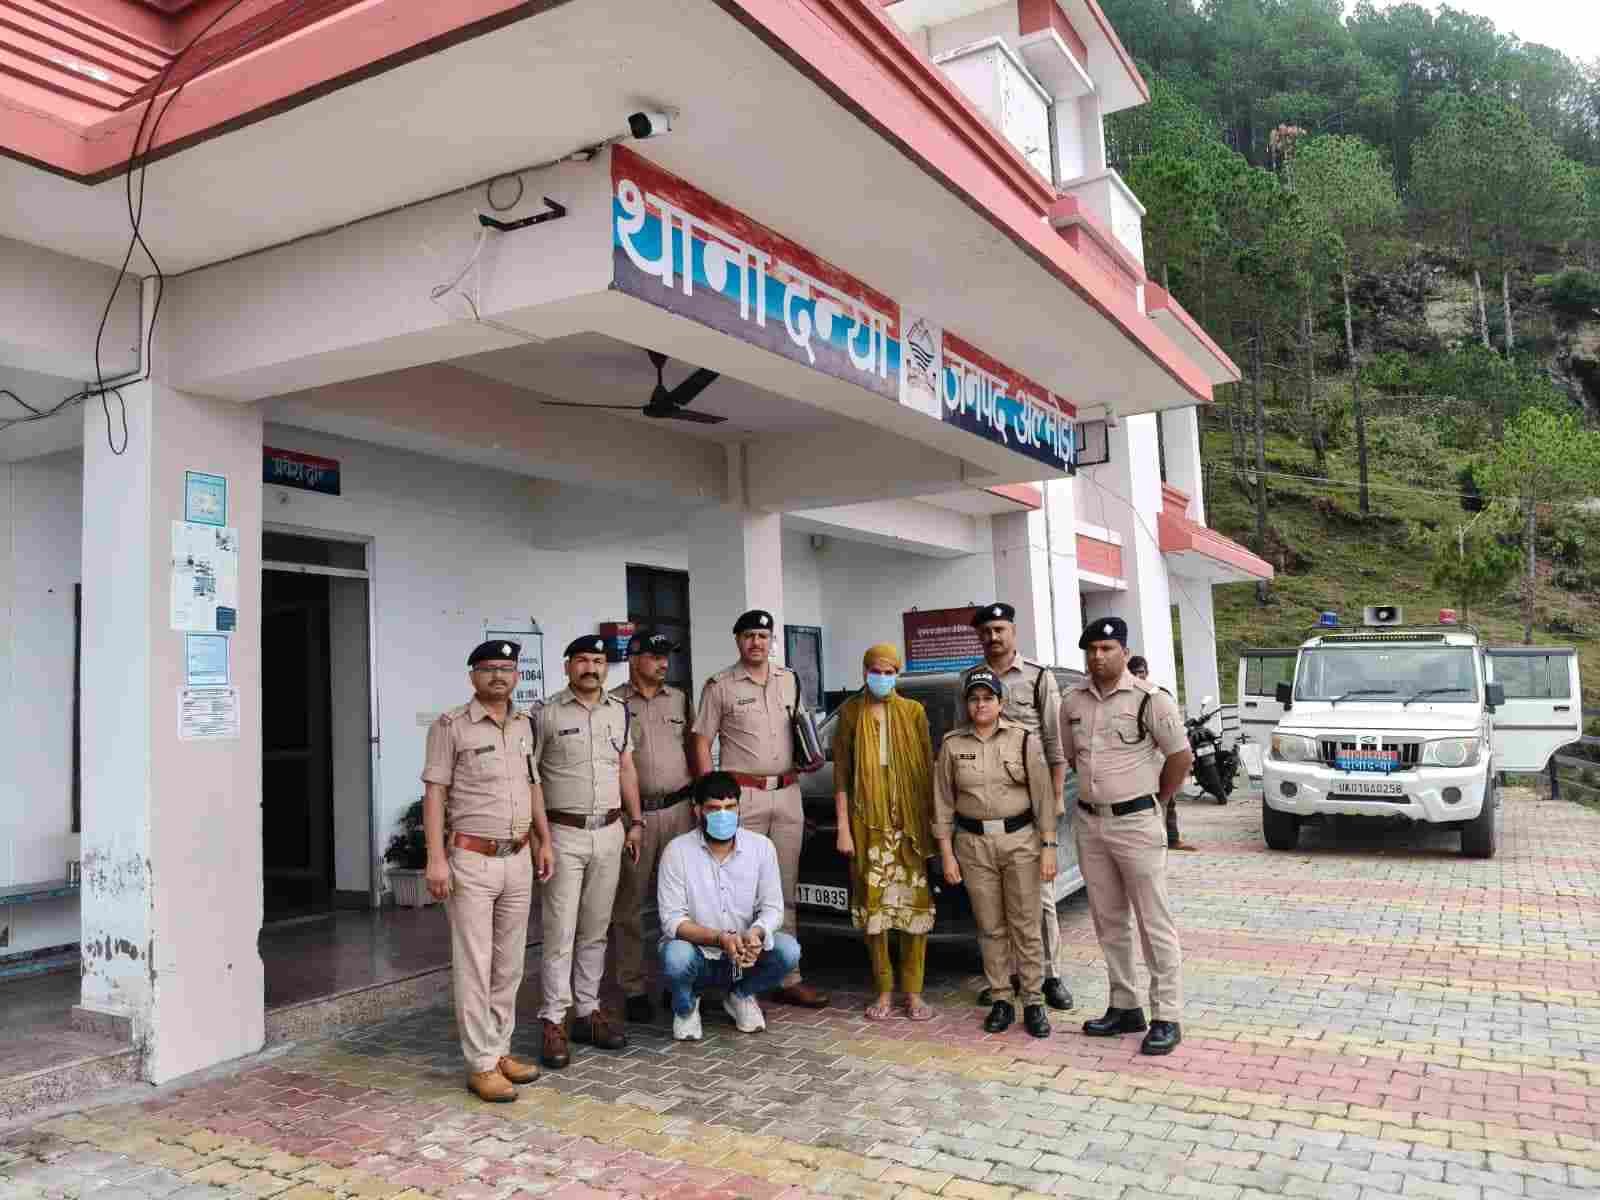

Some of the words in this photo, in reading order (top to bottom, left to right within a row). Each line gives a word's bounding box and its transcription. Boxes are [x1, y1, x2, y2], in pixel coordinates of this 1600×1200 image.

[617, 179, 771, 328] थाना
[774, 260, 894, 379] दन्या
[943, 347, 1009, 444] जनपद
[815, 887, 846, 906] 0835
